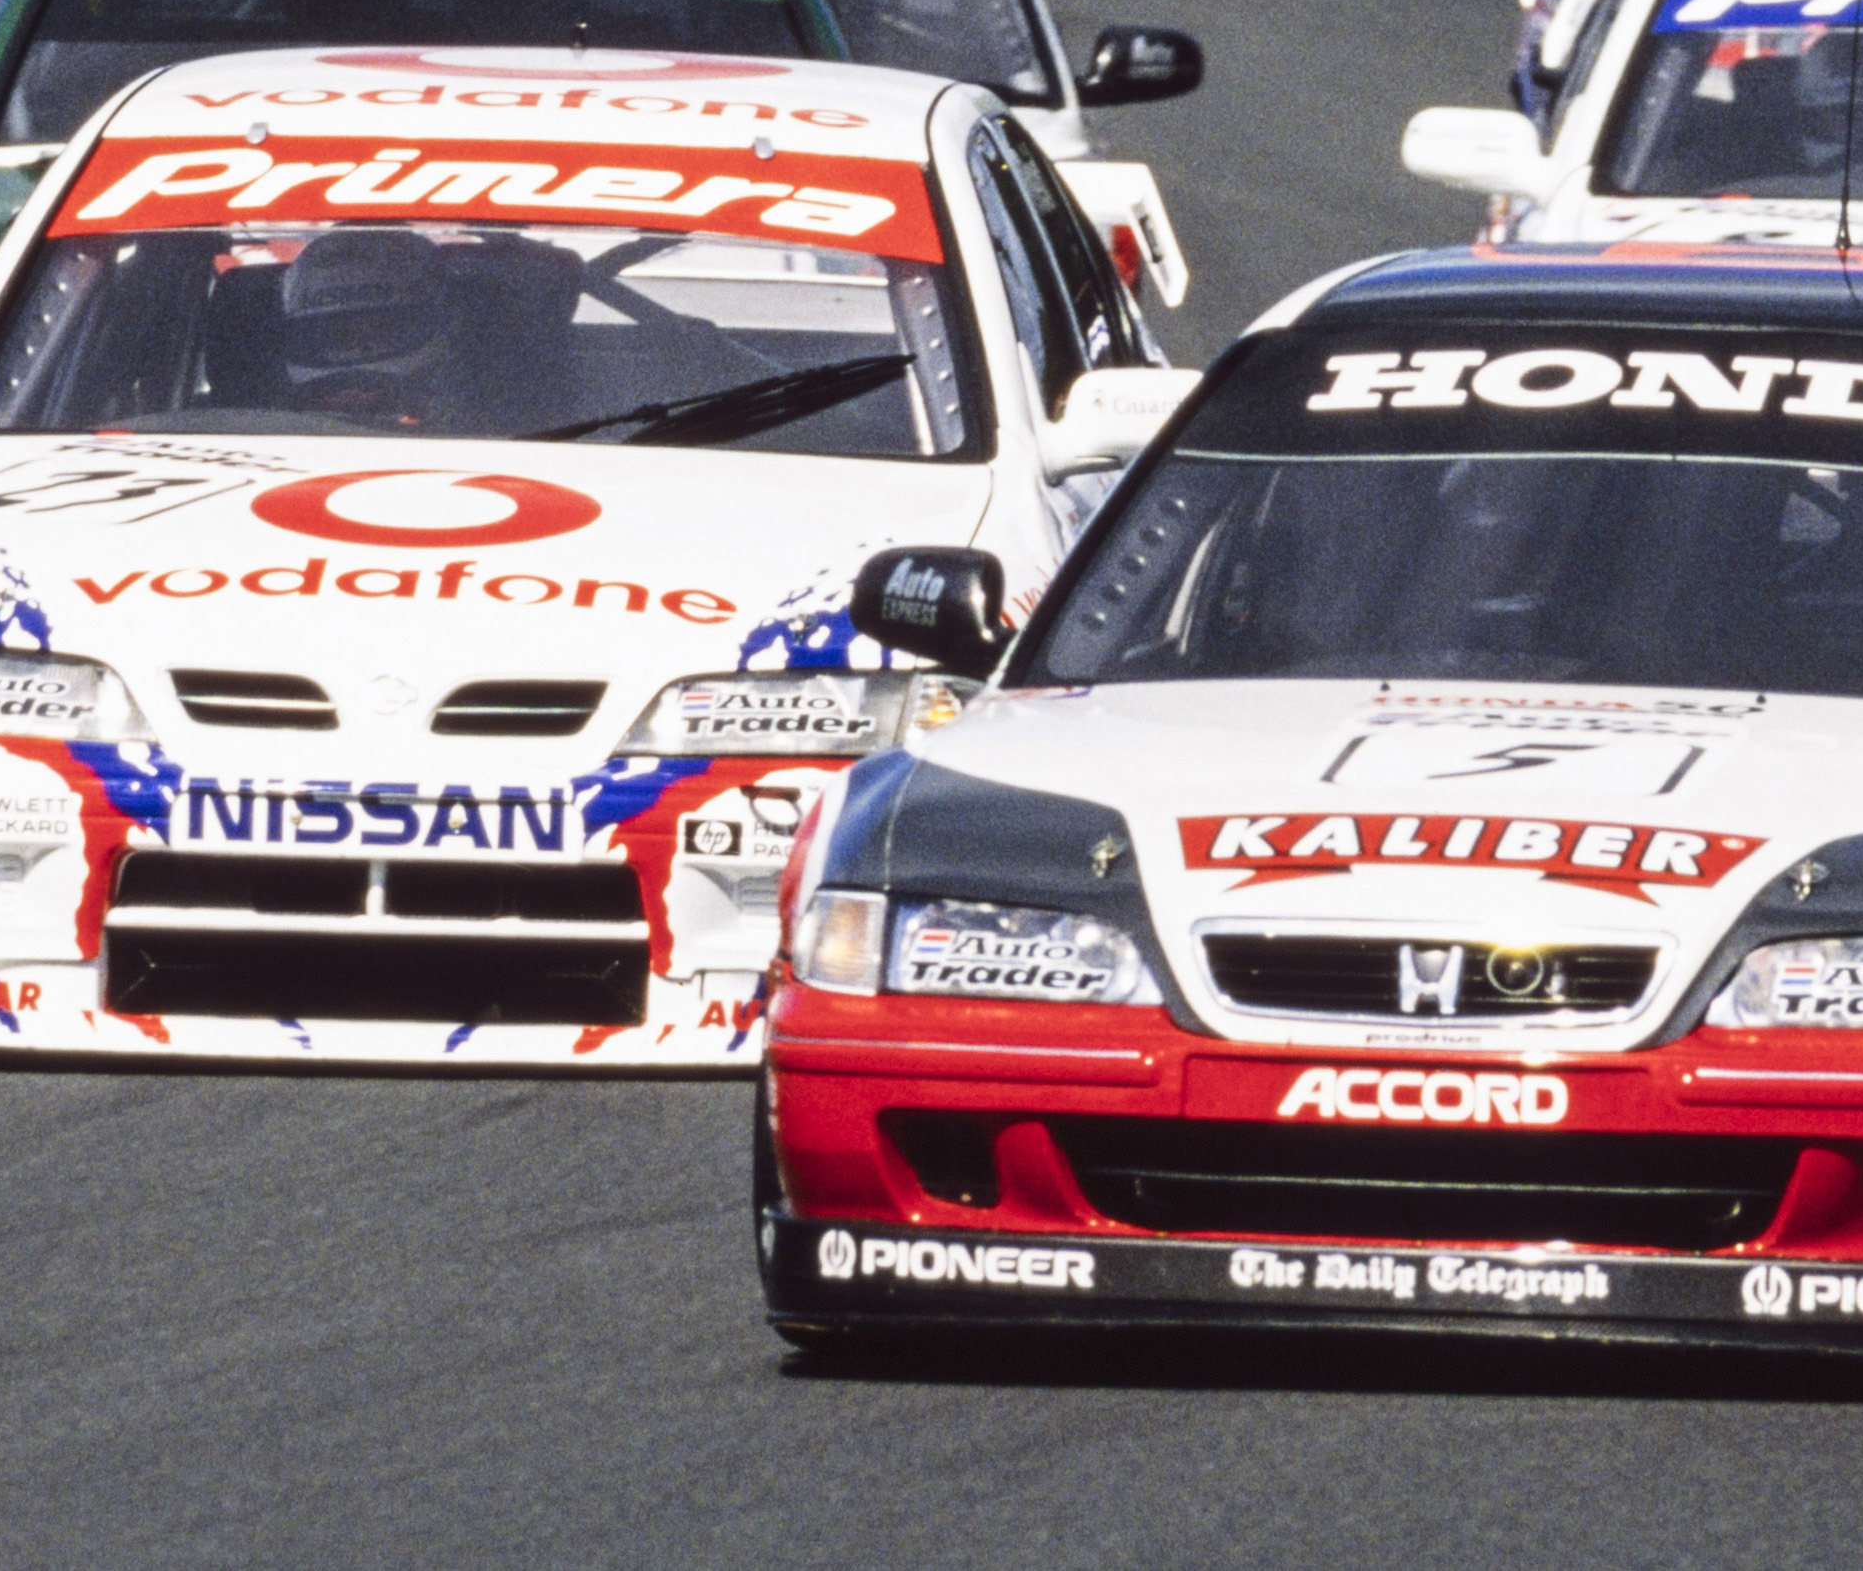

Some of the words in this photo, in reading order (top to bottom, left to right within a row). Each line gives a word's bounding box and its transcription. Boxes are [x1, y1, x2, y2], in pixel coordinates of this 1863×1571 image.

[182, 85, 871, 133] vodafone
[78, 148, 896, 234] Primera
[73, 558, 738, 624] vodafone
[886, 558, 944, 600] Auto
[682, 714, 874, 736] Trader
[715, 692, 836, 710] Auto
[1427, 743, 1604, 780] 5
[187, 777, 563, 851] NISSAN
[1209, 817, 1709, 877] KALIBER
[951, 933, 1076, 960] Auto
[910, 961, 1105, 994] Trader
[1366, 1031, 1481, 1047] prodrive
[1278, 1070, 1569, 1125] ACCORD
[861, 1240, 1095, 1289] PIONEER
[1230, 1249, 1304, 1289] The
[1314, 1255, 1416, 1298] Daily
[1428, 1254, 1610, 1304] Telegraph
